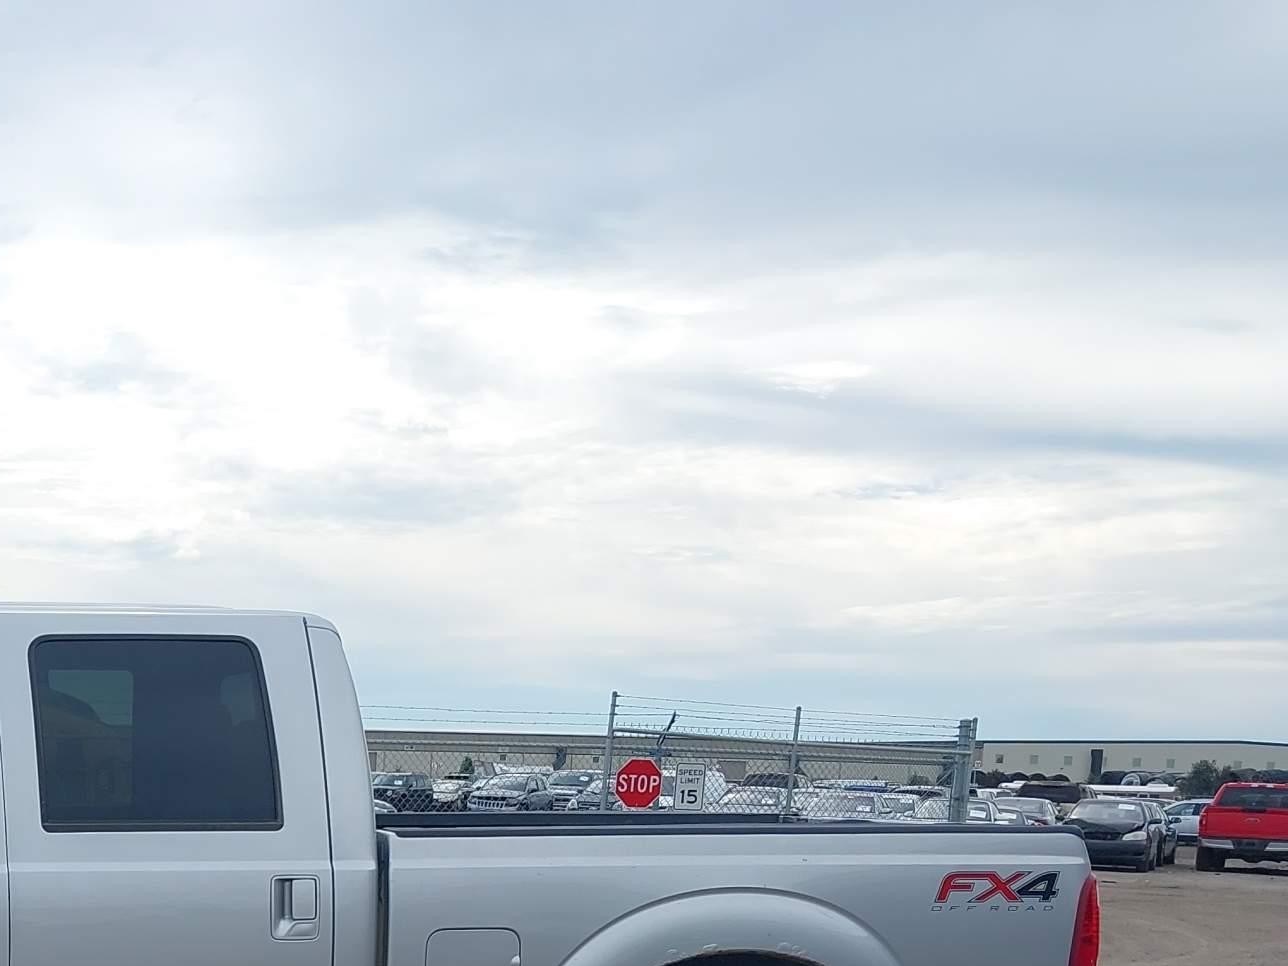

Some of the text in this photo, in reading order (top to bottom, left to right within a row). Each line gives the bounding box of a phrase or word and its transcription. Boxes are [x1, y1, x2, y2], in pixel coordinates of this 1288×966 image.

[678, 768, 704, 776] SPEED
[617, 774, 660, 793] STOP
[679, 777, 700, 785] LIMIT
[680, 789, 698, 804] 15
[933, 870, 1061, 904] FX4
